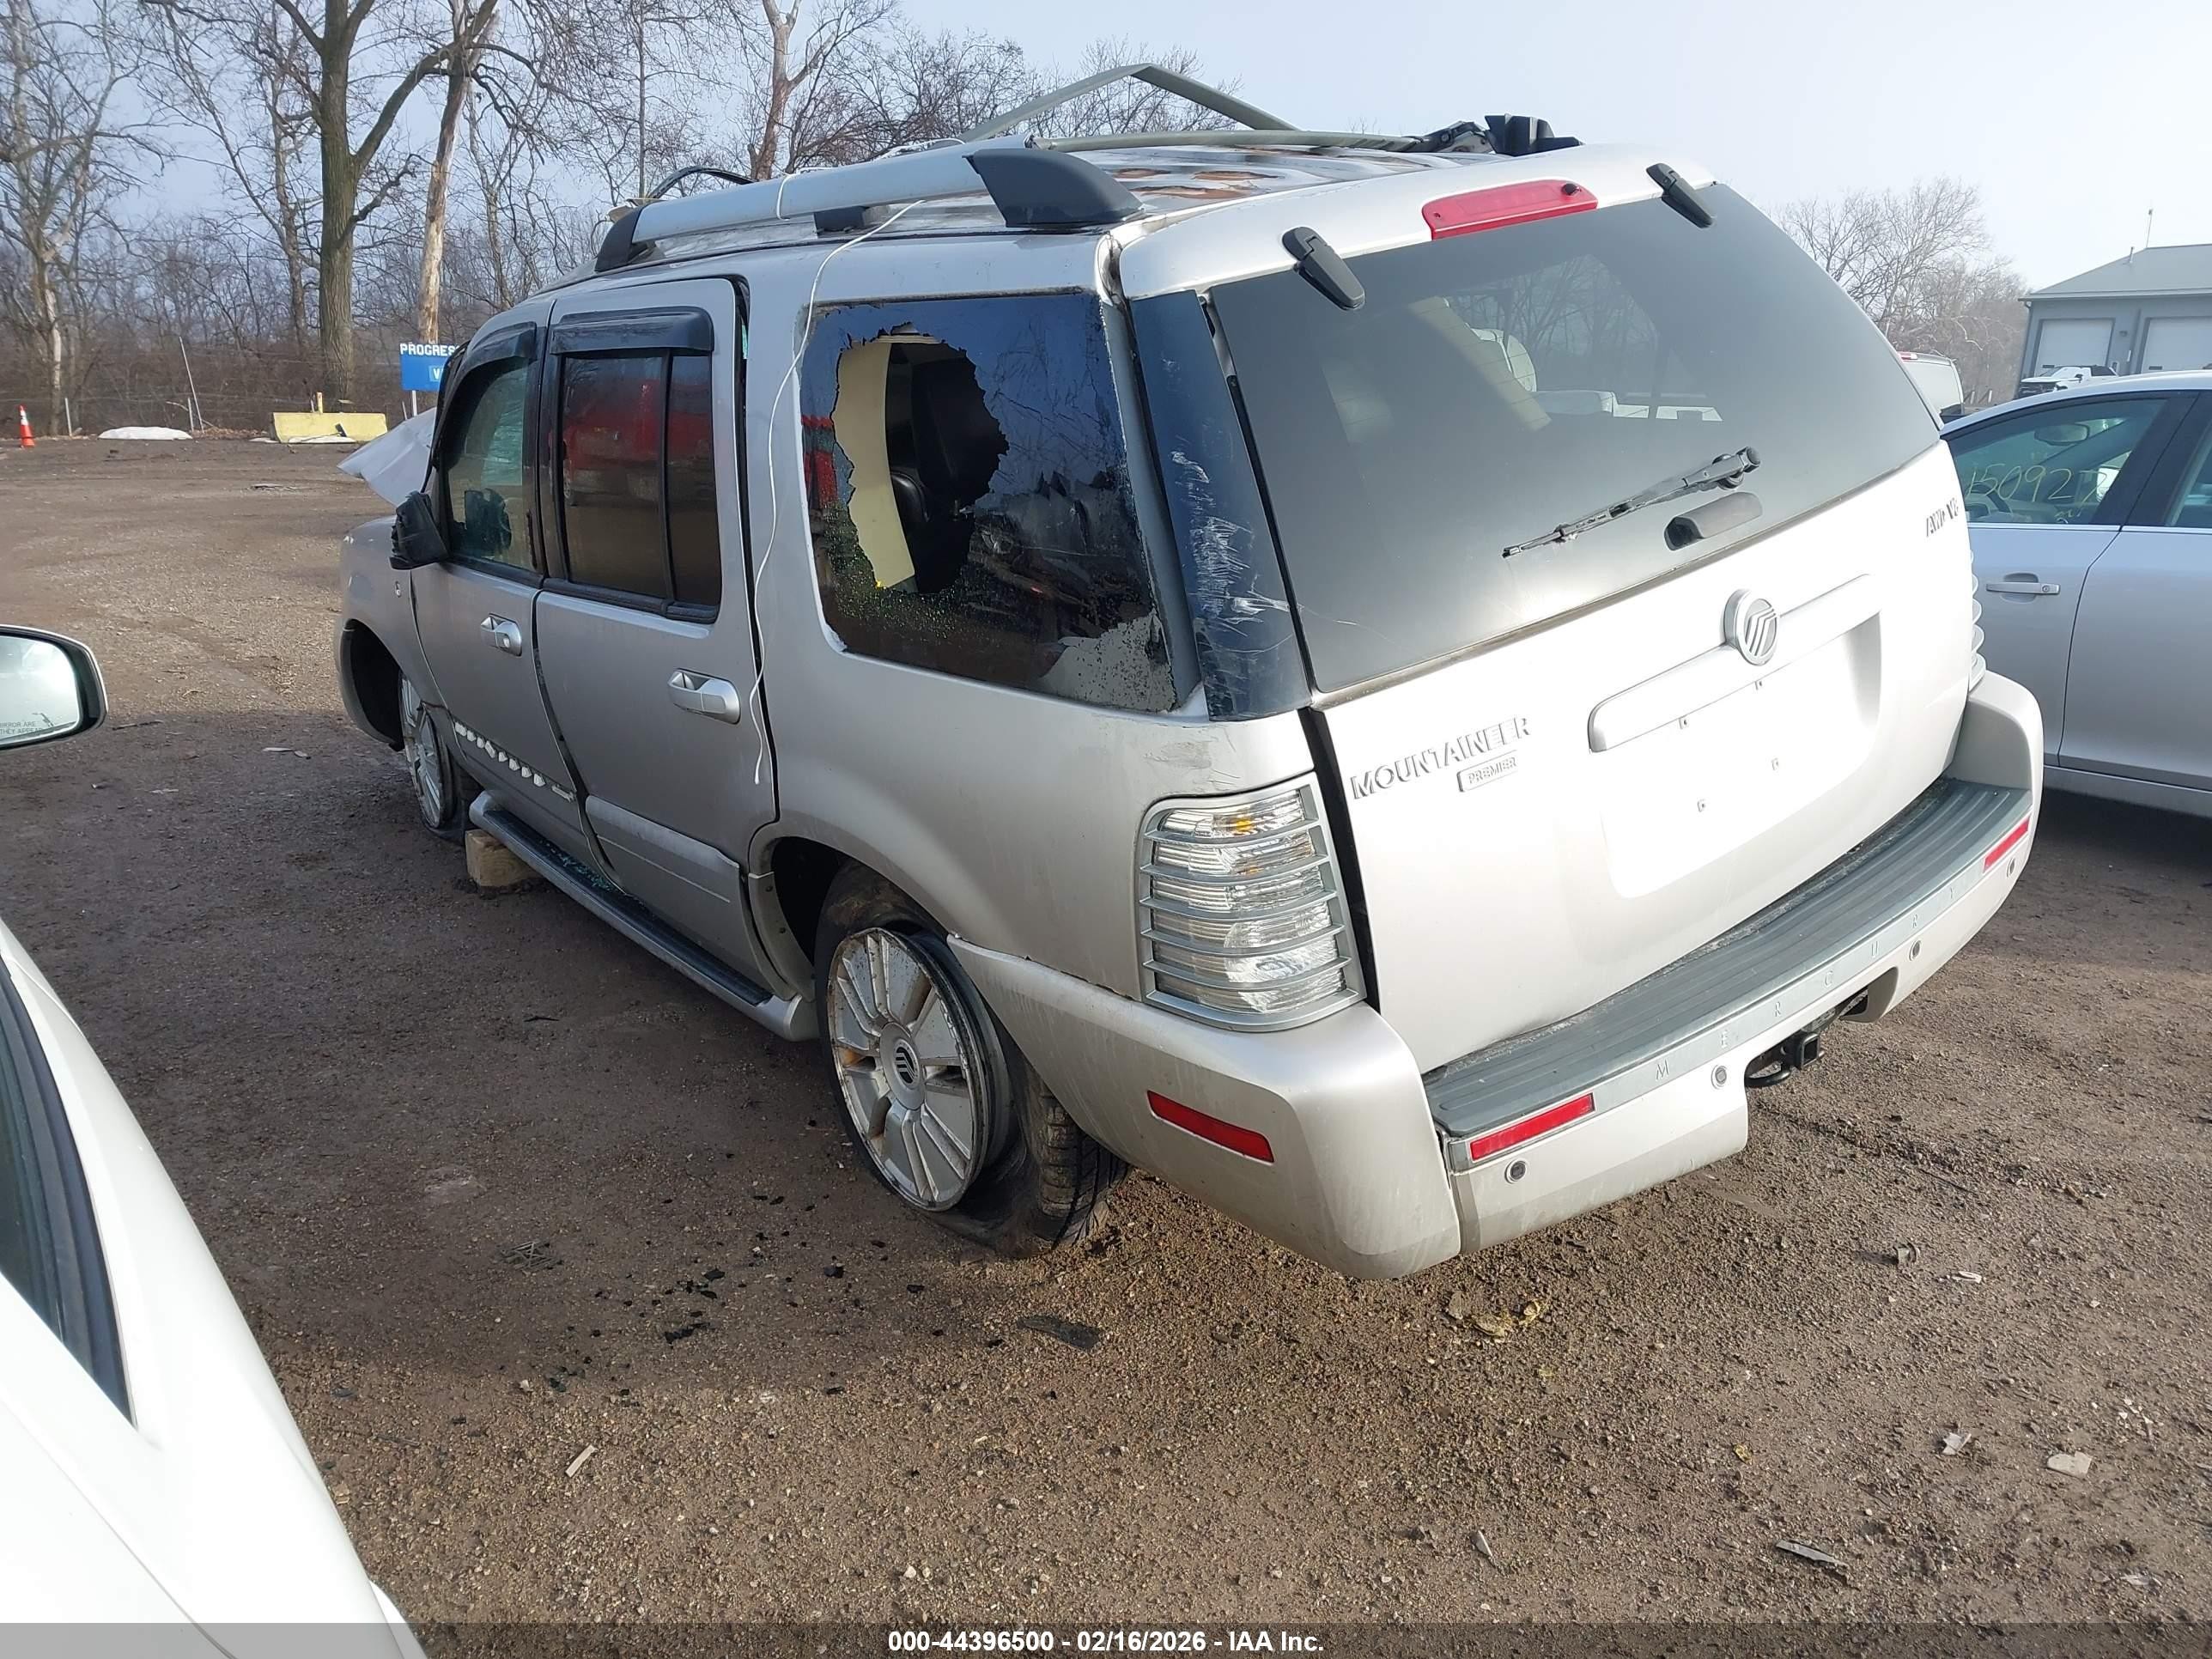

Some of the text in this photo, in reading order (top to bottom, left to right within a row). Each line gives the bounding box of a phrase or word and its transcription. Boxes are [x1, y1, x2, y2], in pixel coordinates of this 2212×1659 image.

[399, 343, 459, 356] PROGRES
[1350, 716, 1531, 800] MOUNTAINEER
[1468, 756, 1517, 785] PREMIER
